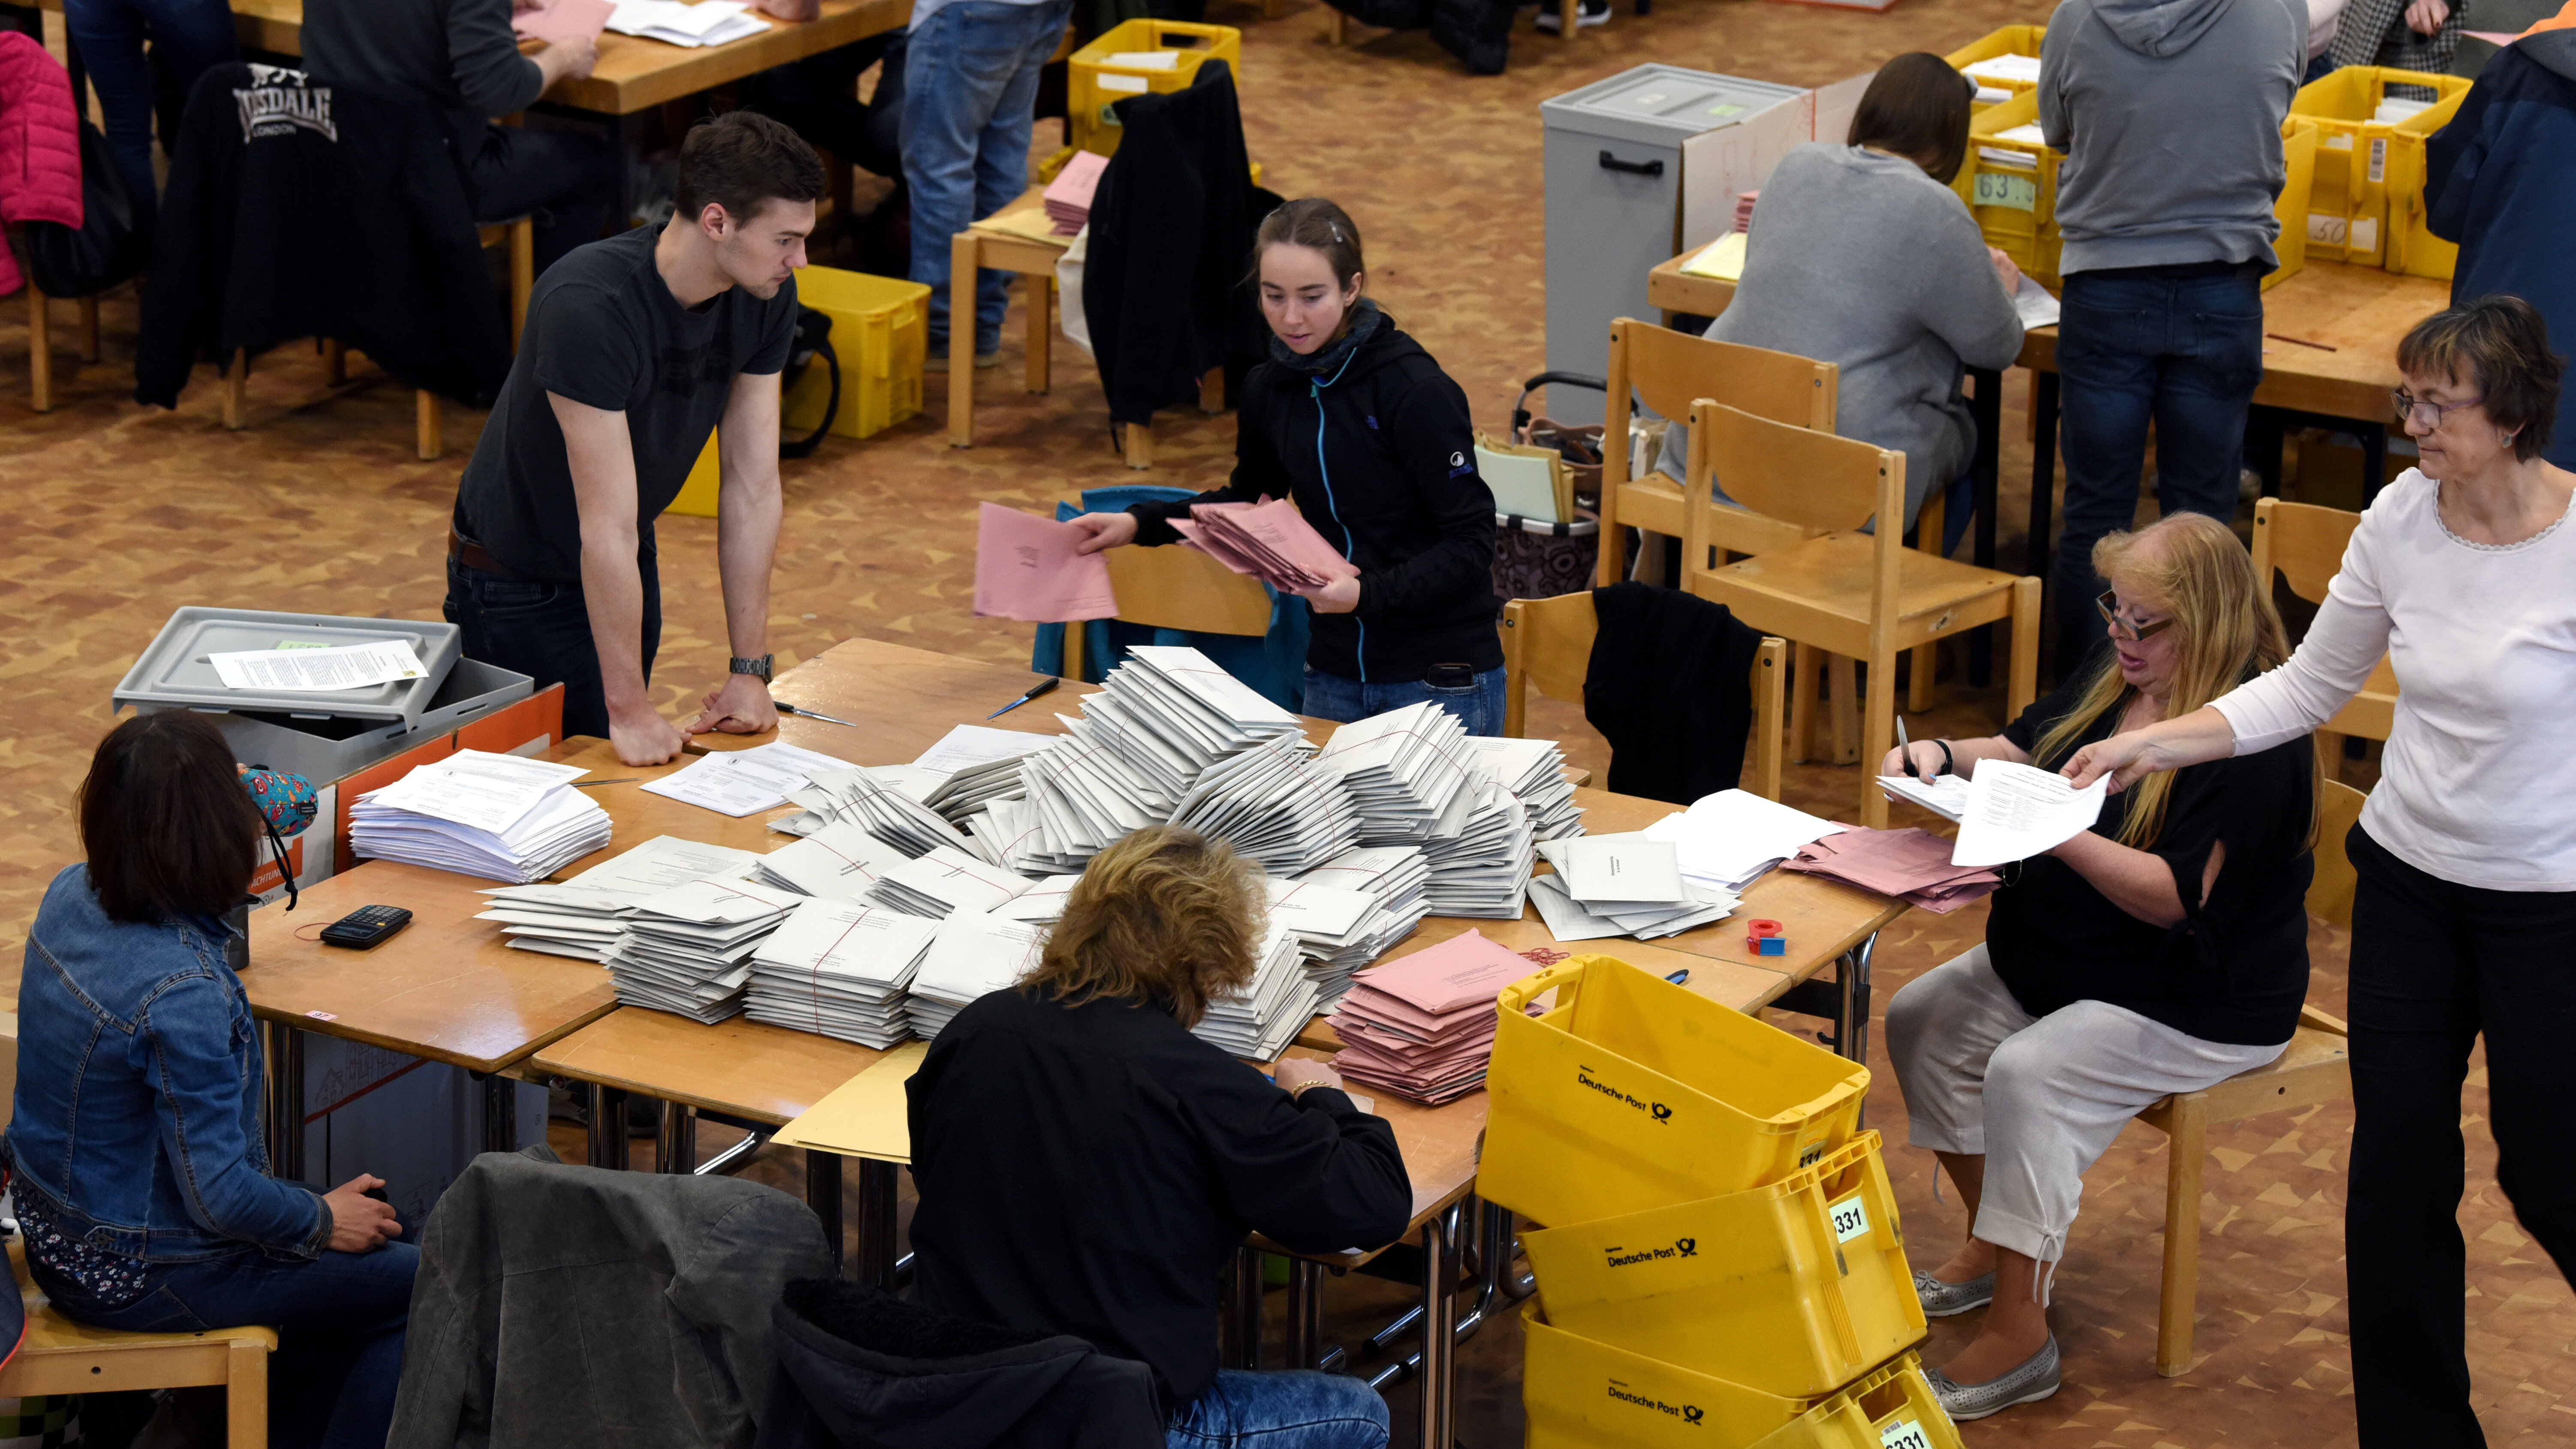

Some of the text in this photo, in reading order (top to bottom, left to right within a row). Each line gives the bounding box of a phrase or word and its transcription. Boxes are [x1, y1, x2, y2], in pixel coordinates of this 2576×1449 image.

[2314, 220, 2347, 244] 50
[251, 868, 283, 888] ACHTUN
[1578, 1073, 1646, 1112] Deutsche Post
[1832, 1207, 1862, 1234] 331
[1607, 1247, 1676, 1268] Deutsche Post
[1609, 1378, 1629, 1387] Eigentum
[1608, 1386, 1679, 1416] Deutsche Post
